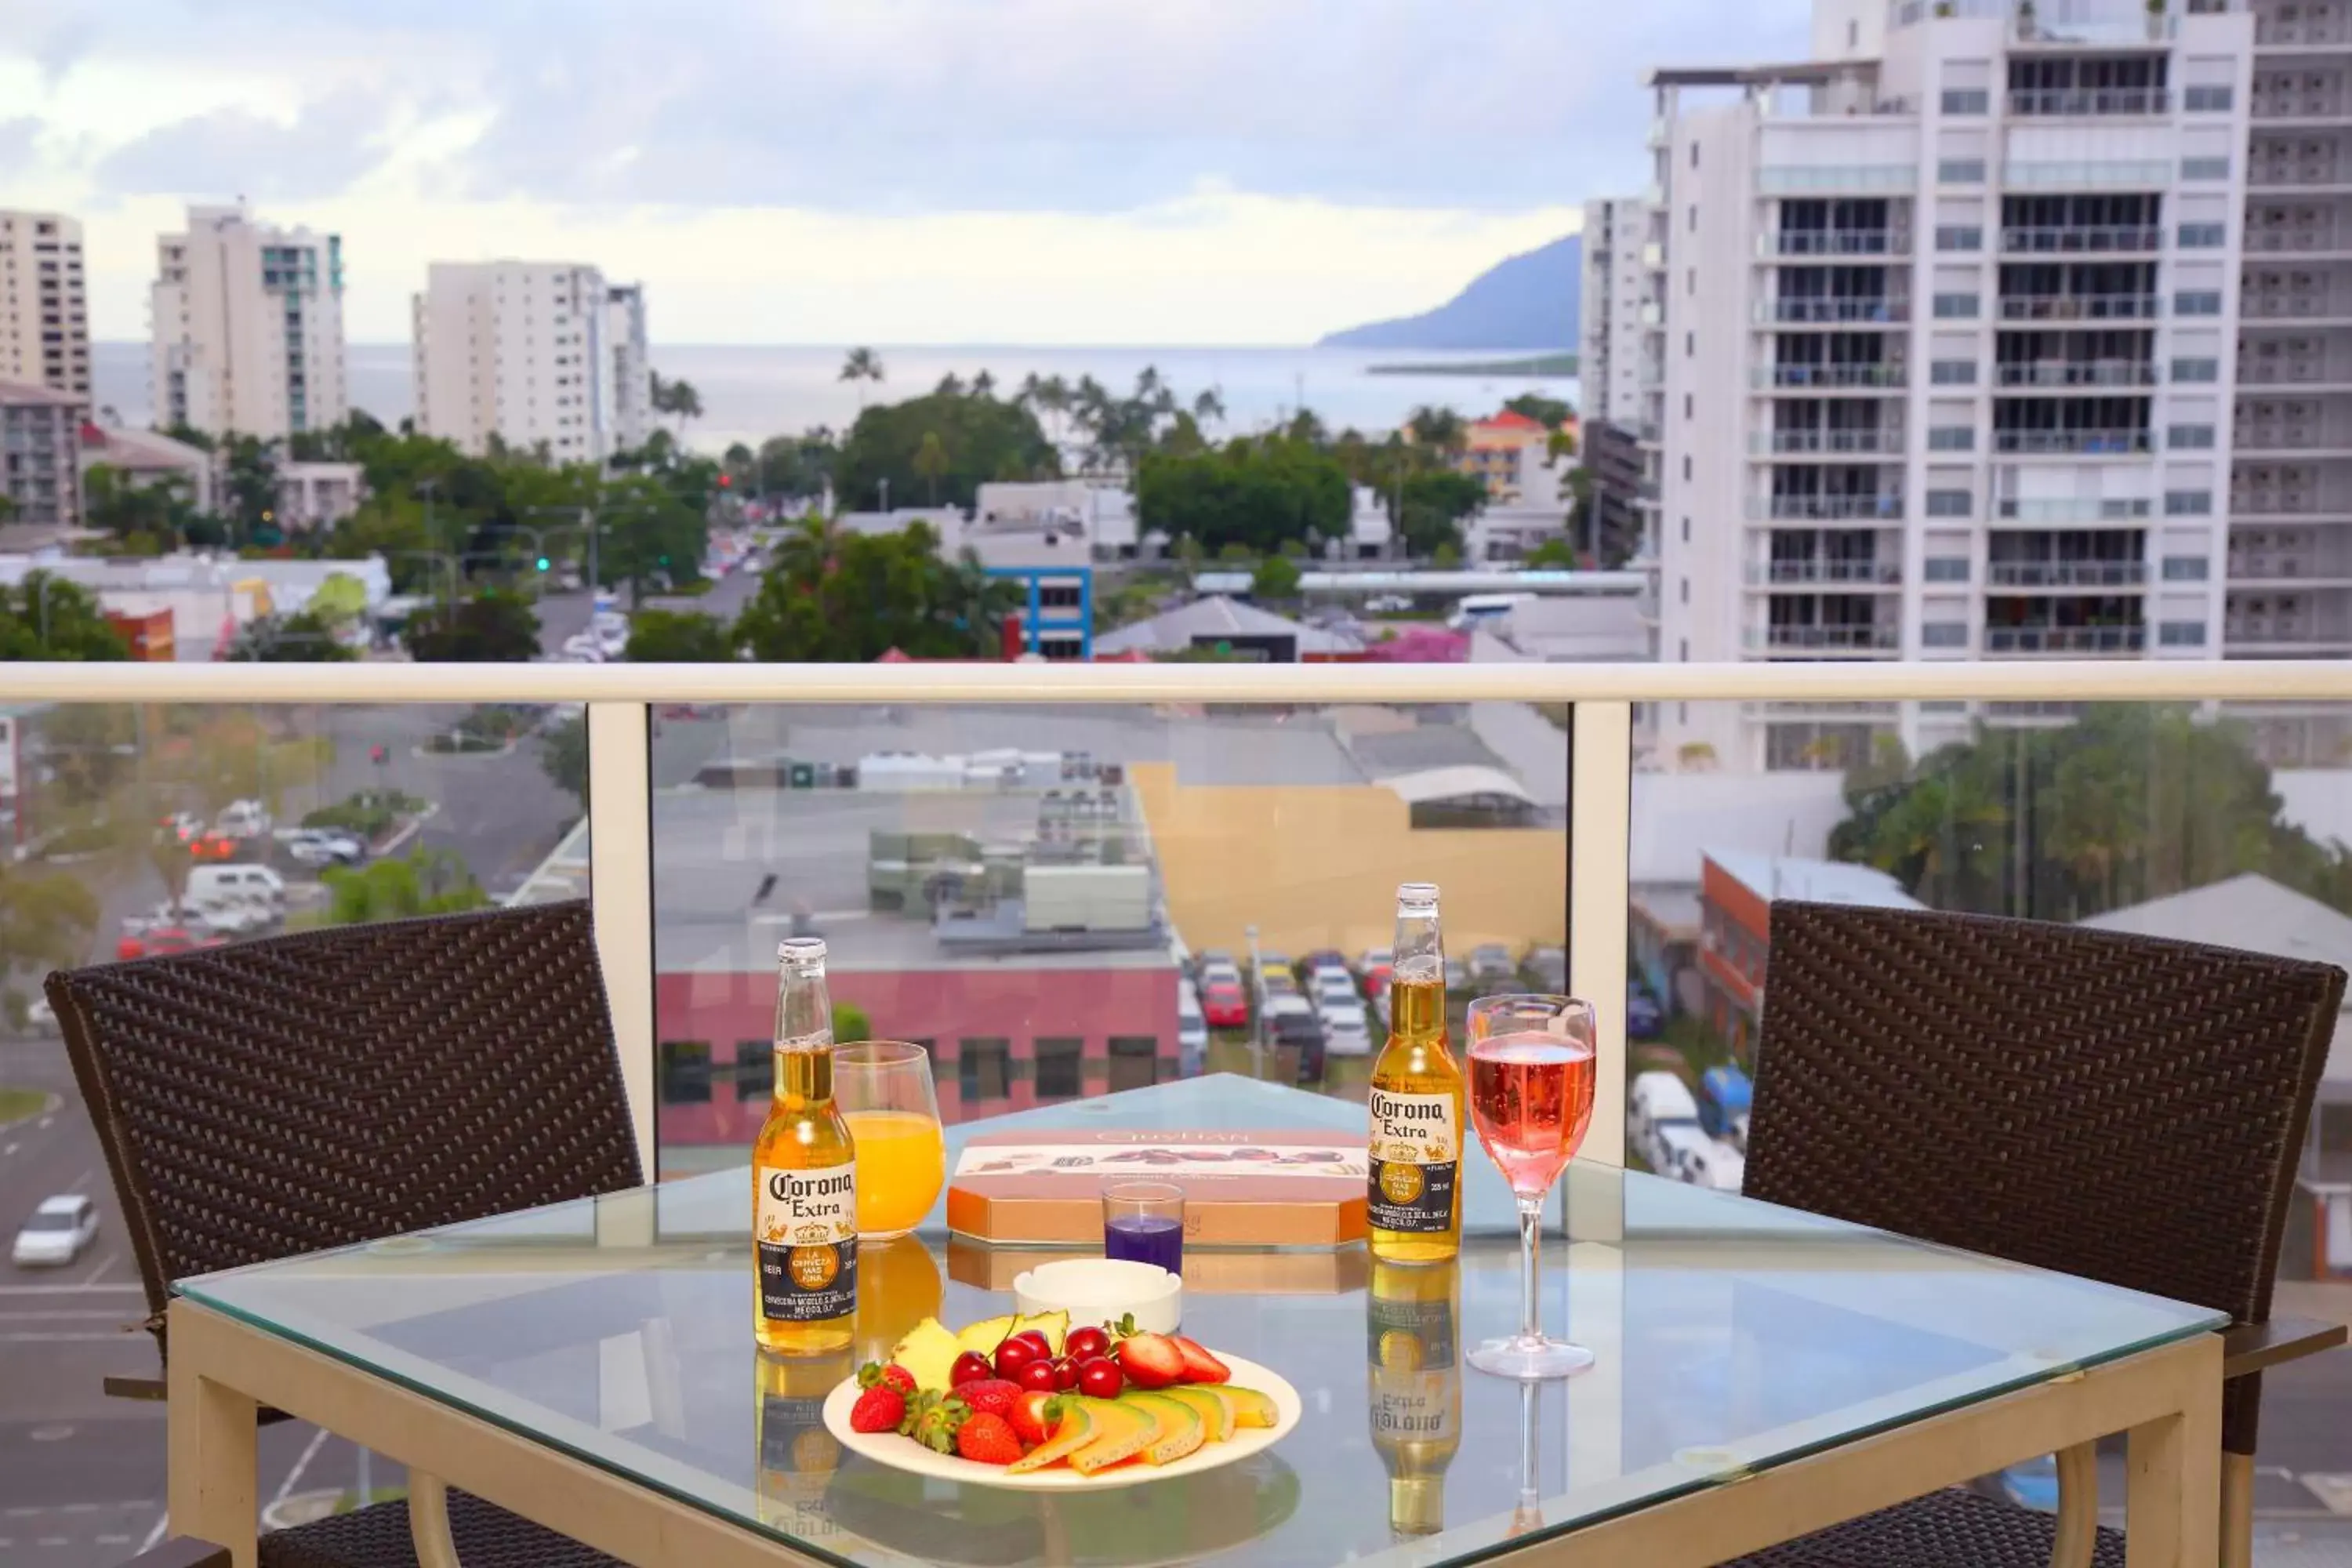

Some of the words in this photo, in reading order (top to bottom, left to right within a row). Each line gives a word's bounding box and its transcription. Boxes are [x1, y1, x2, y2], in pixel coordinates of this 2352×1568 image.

[1371, 1093, 1443, 1120] Corona
[1383, 1120, 1427, 1138] Extra
[769, 1173, 852, 1203] Corona
[792, 1200, 840, 1217] Extra
